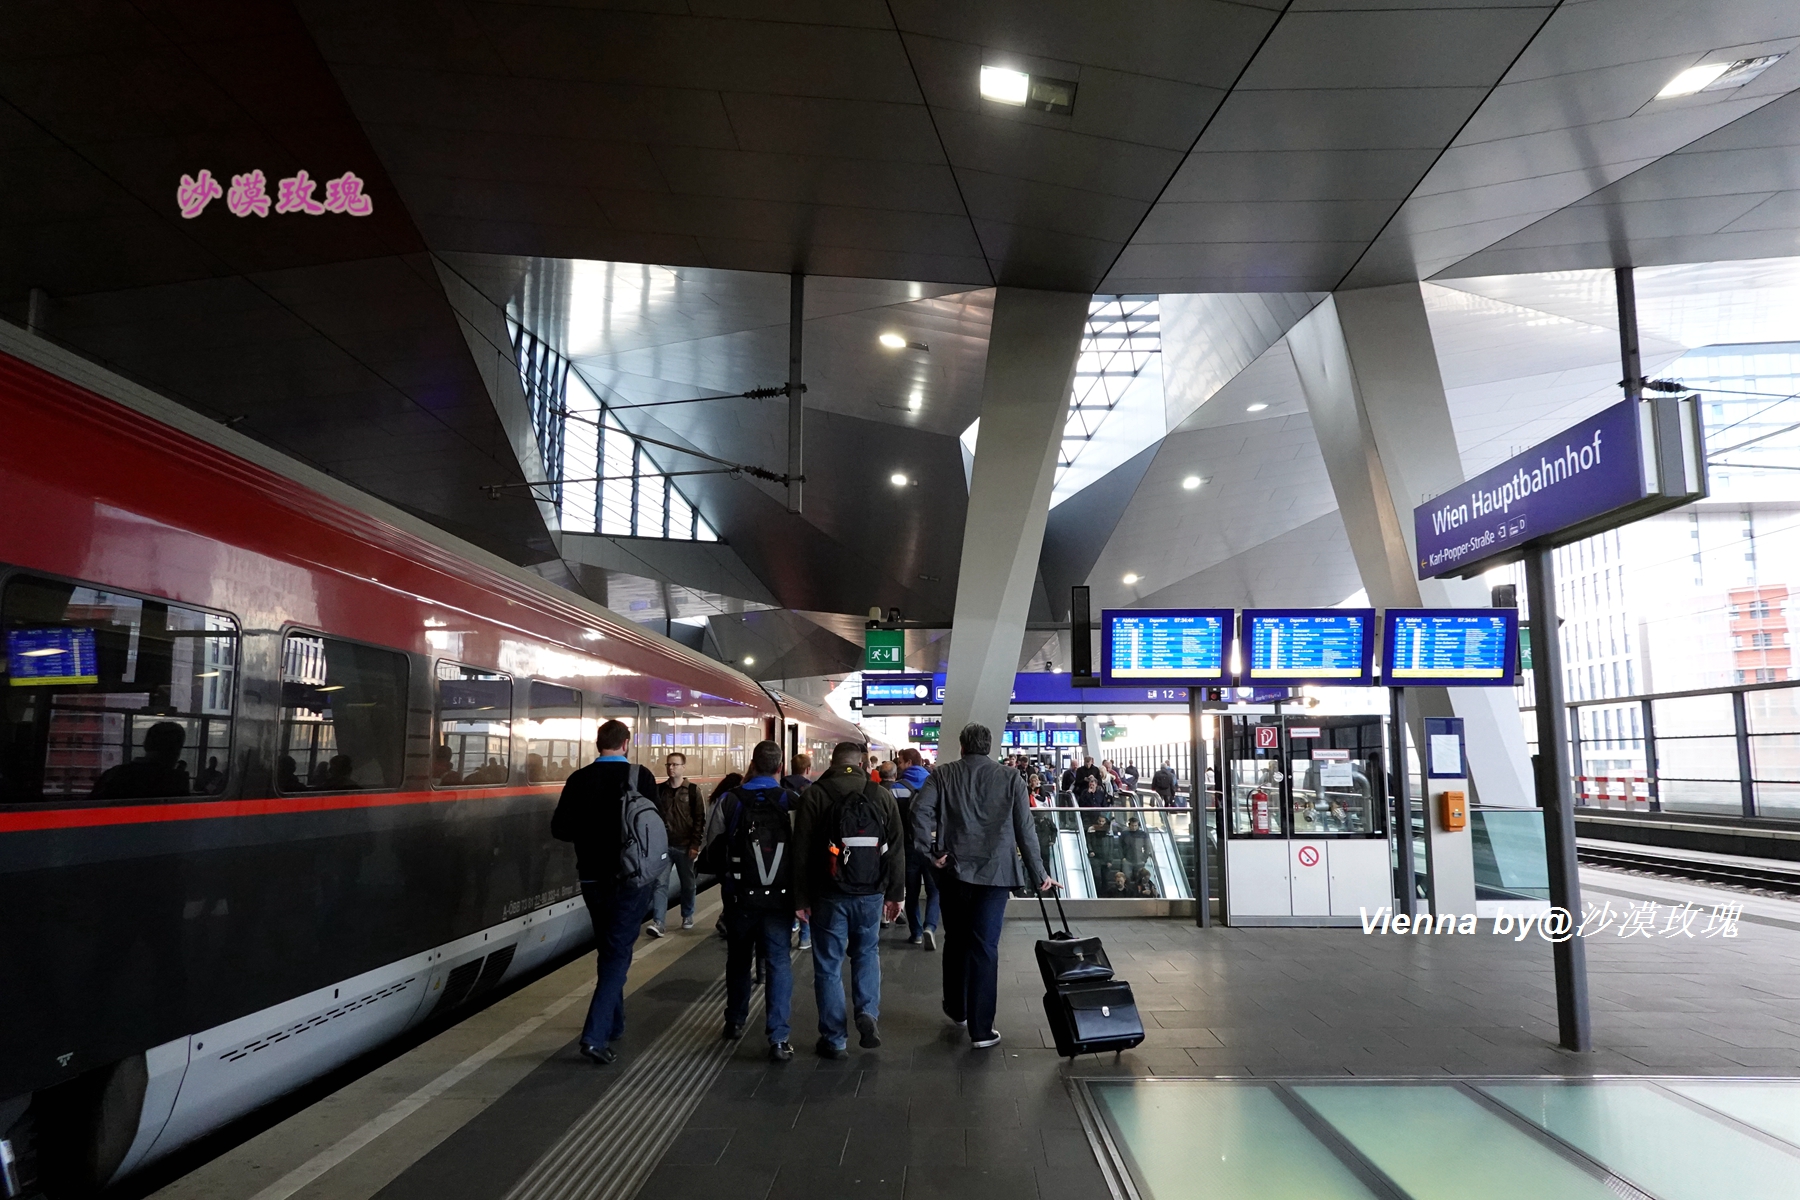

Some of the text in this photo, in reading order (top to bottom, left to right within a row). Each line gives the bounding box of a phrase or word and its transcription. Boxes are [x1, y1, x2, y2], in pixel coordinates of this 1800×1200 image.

[1432, 429, 1602, 536] Wien Hauptbahnhof
[1429, 530, 1495, 567] Karl-Popper-Straße
[1162, 689, 1174, 699] 12
[910, 728, 918, 736] 11
